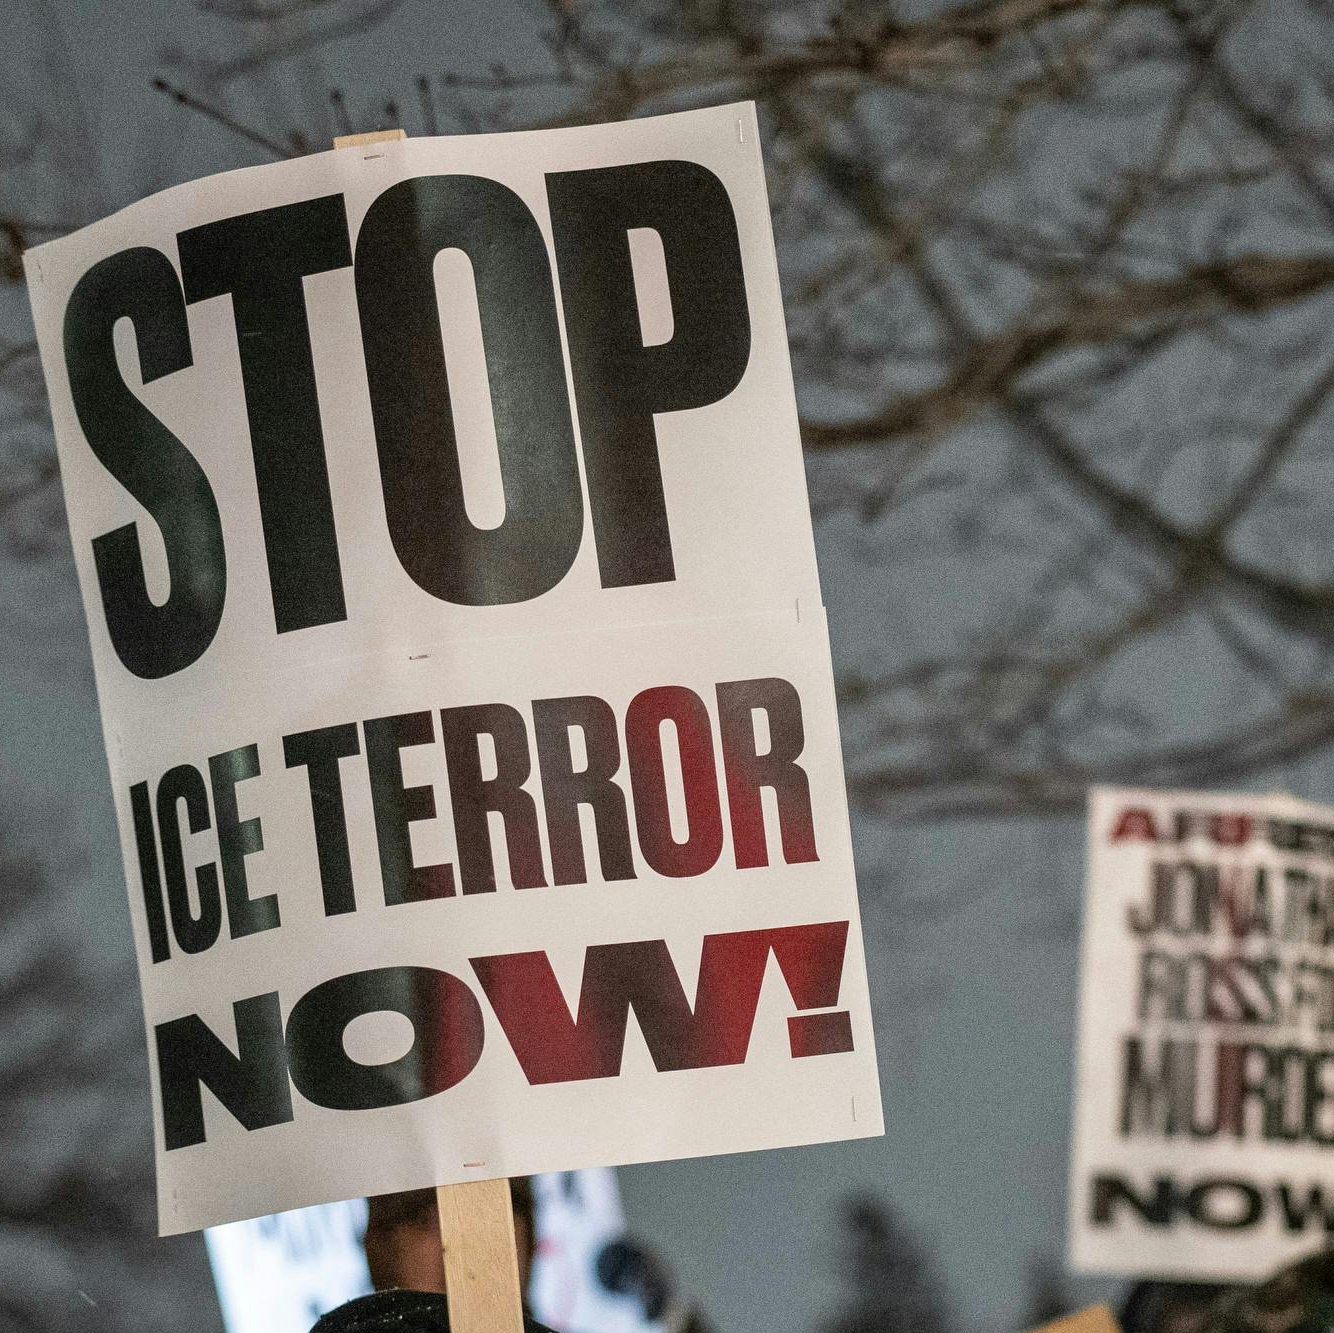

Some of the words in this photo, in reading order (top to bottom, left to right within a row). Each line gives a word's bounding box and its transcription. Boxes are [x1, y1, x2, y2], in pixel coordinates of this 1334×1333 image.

[63, 158, 753, 681] STOP
[128, 744, 282, 966] ICE
[282, 677, 821, 918] TERROR
[153, 920, 857, 1152] NOW!
